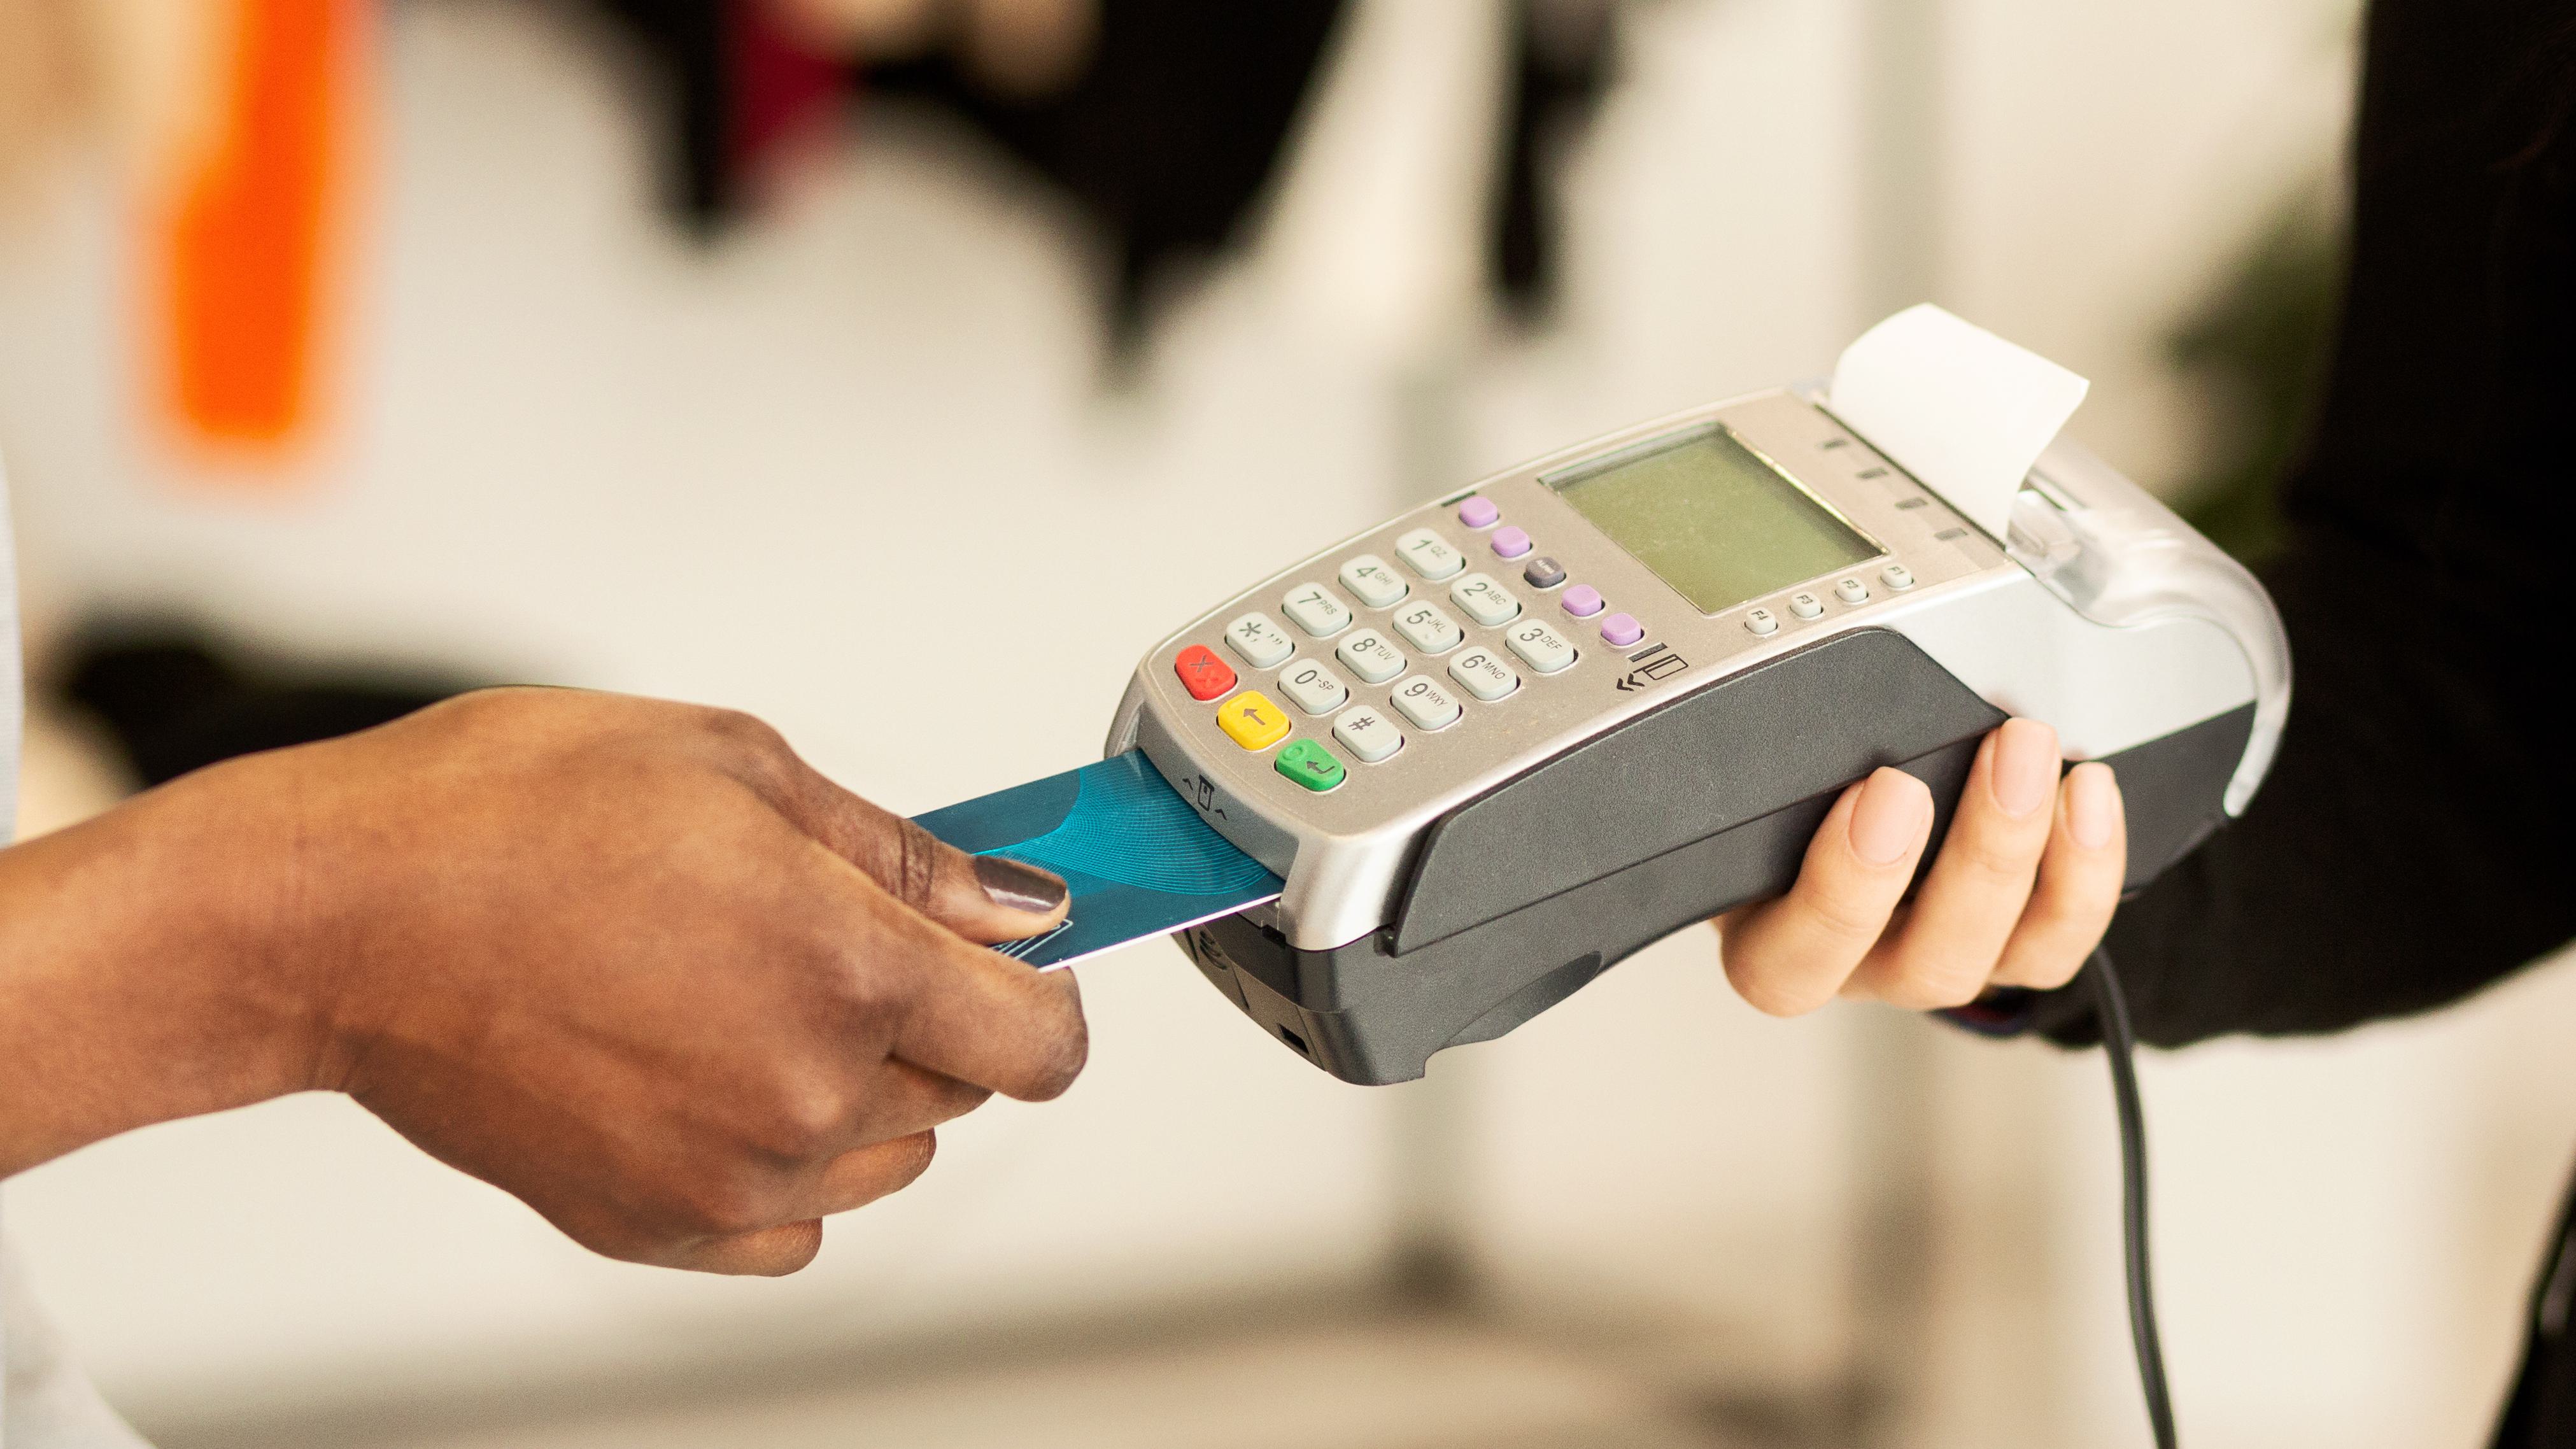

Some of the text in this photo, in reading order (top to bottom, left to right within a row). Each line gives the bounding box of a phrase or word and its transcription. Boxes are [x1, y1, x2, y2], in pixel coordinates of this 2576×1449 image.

[1412, 539, 1447, 559] 1 QZ
[1356, 567, 1394, 586] 4 GHI
[1888, 565, 1905, 576] F1
[1462, 582, 1506, 605] 2 ABC
[1842, 579, 1859, 590] F2
[1297, 591, 1338, 616] 7 PRS
[1796, 594, 1813, 605] F3
[1406, 609, 1447, 633] 5 JKL
[1751, 609, 1769, 621] F4
[1352, 638, 1395, 660] 8 TUV
[1519, 628, 1562, 651] 3 DEF
[1294, 669, 1318, 684] 0
[1462, 654, 1506, 680] 6 MNO
[1405, 682, 1448, 707] 9 WXY
